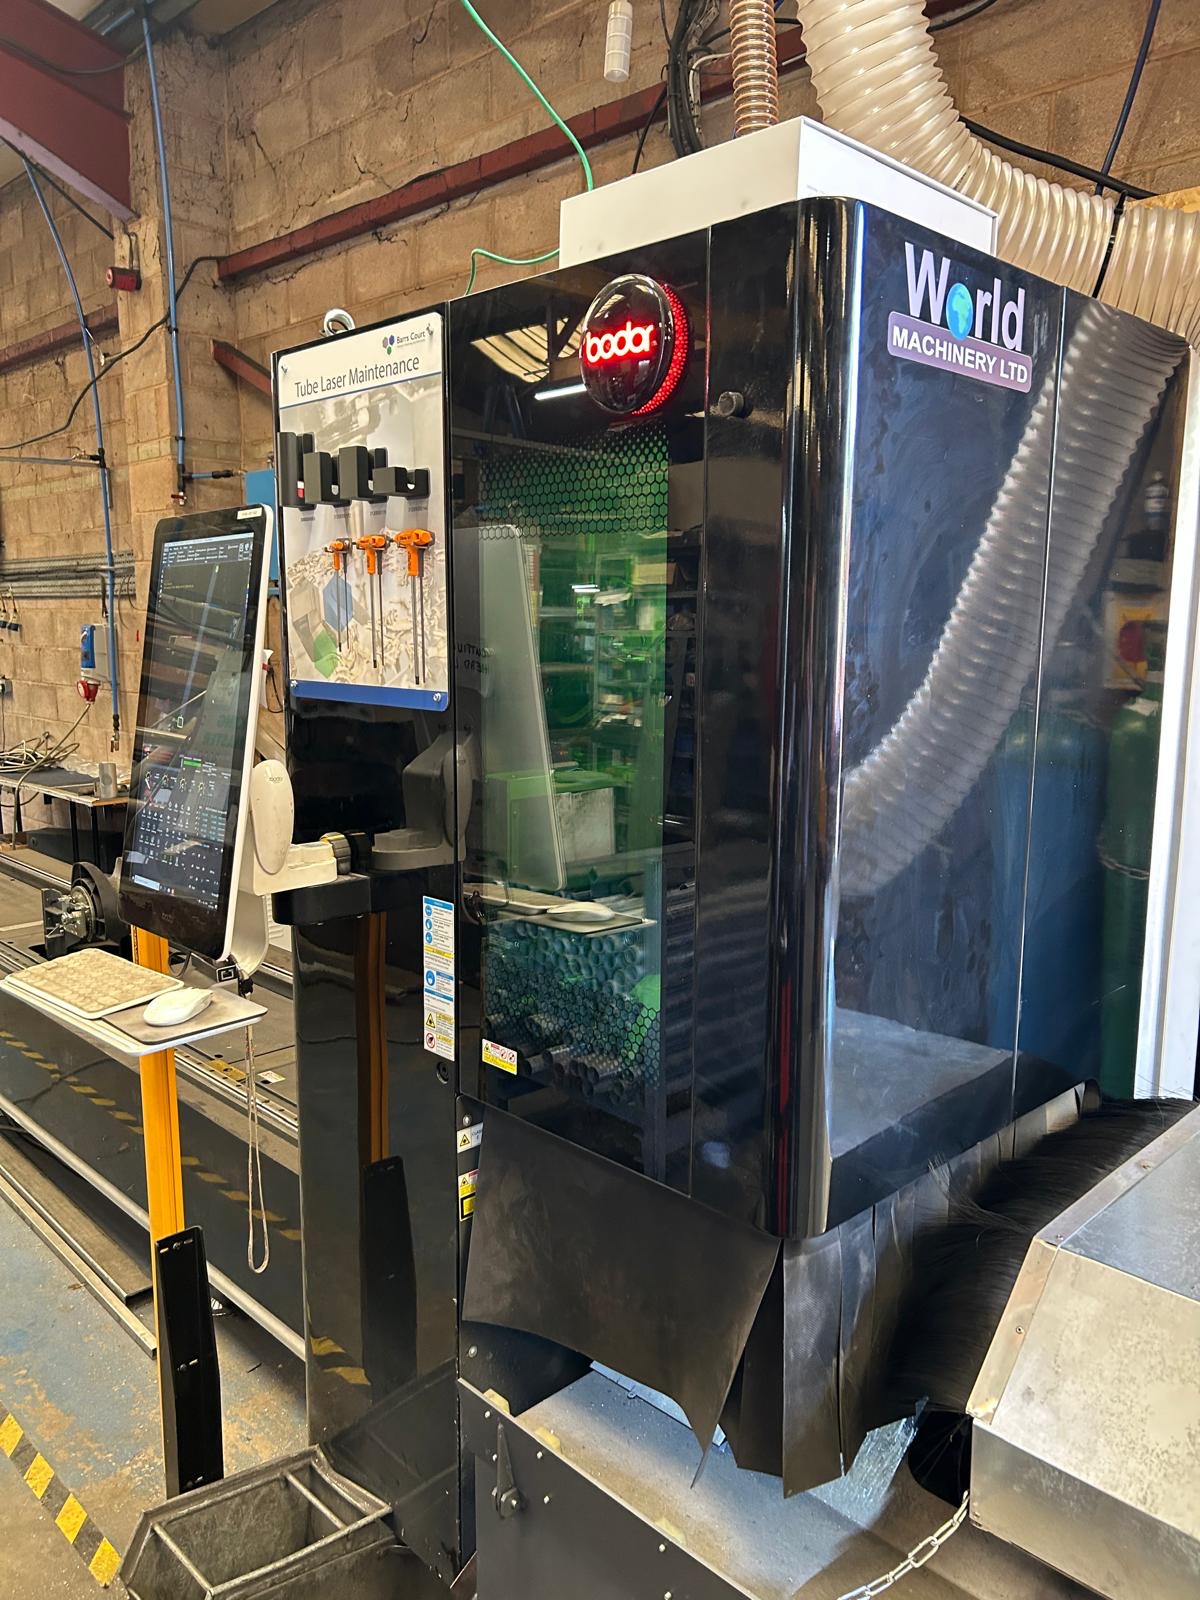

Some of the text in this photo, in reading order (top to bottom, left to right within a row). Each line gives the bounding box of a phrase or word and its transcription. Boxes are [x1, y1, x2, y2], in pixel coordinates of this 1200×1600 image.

[410, 331, 426, 340] Court
[585, 321, 655, 363] bodor
[892, 325, 1028, 384] MACHINERY LTD
[294, 356, 420, 398] Tube Laser Maintenance
